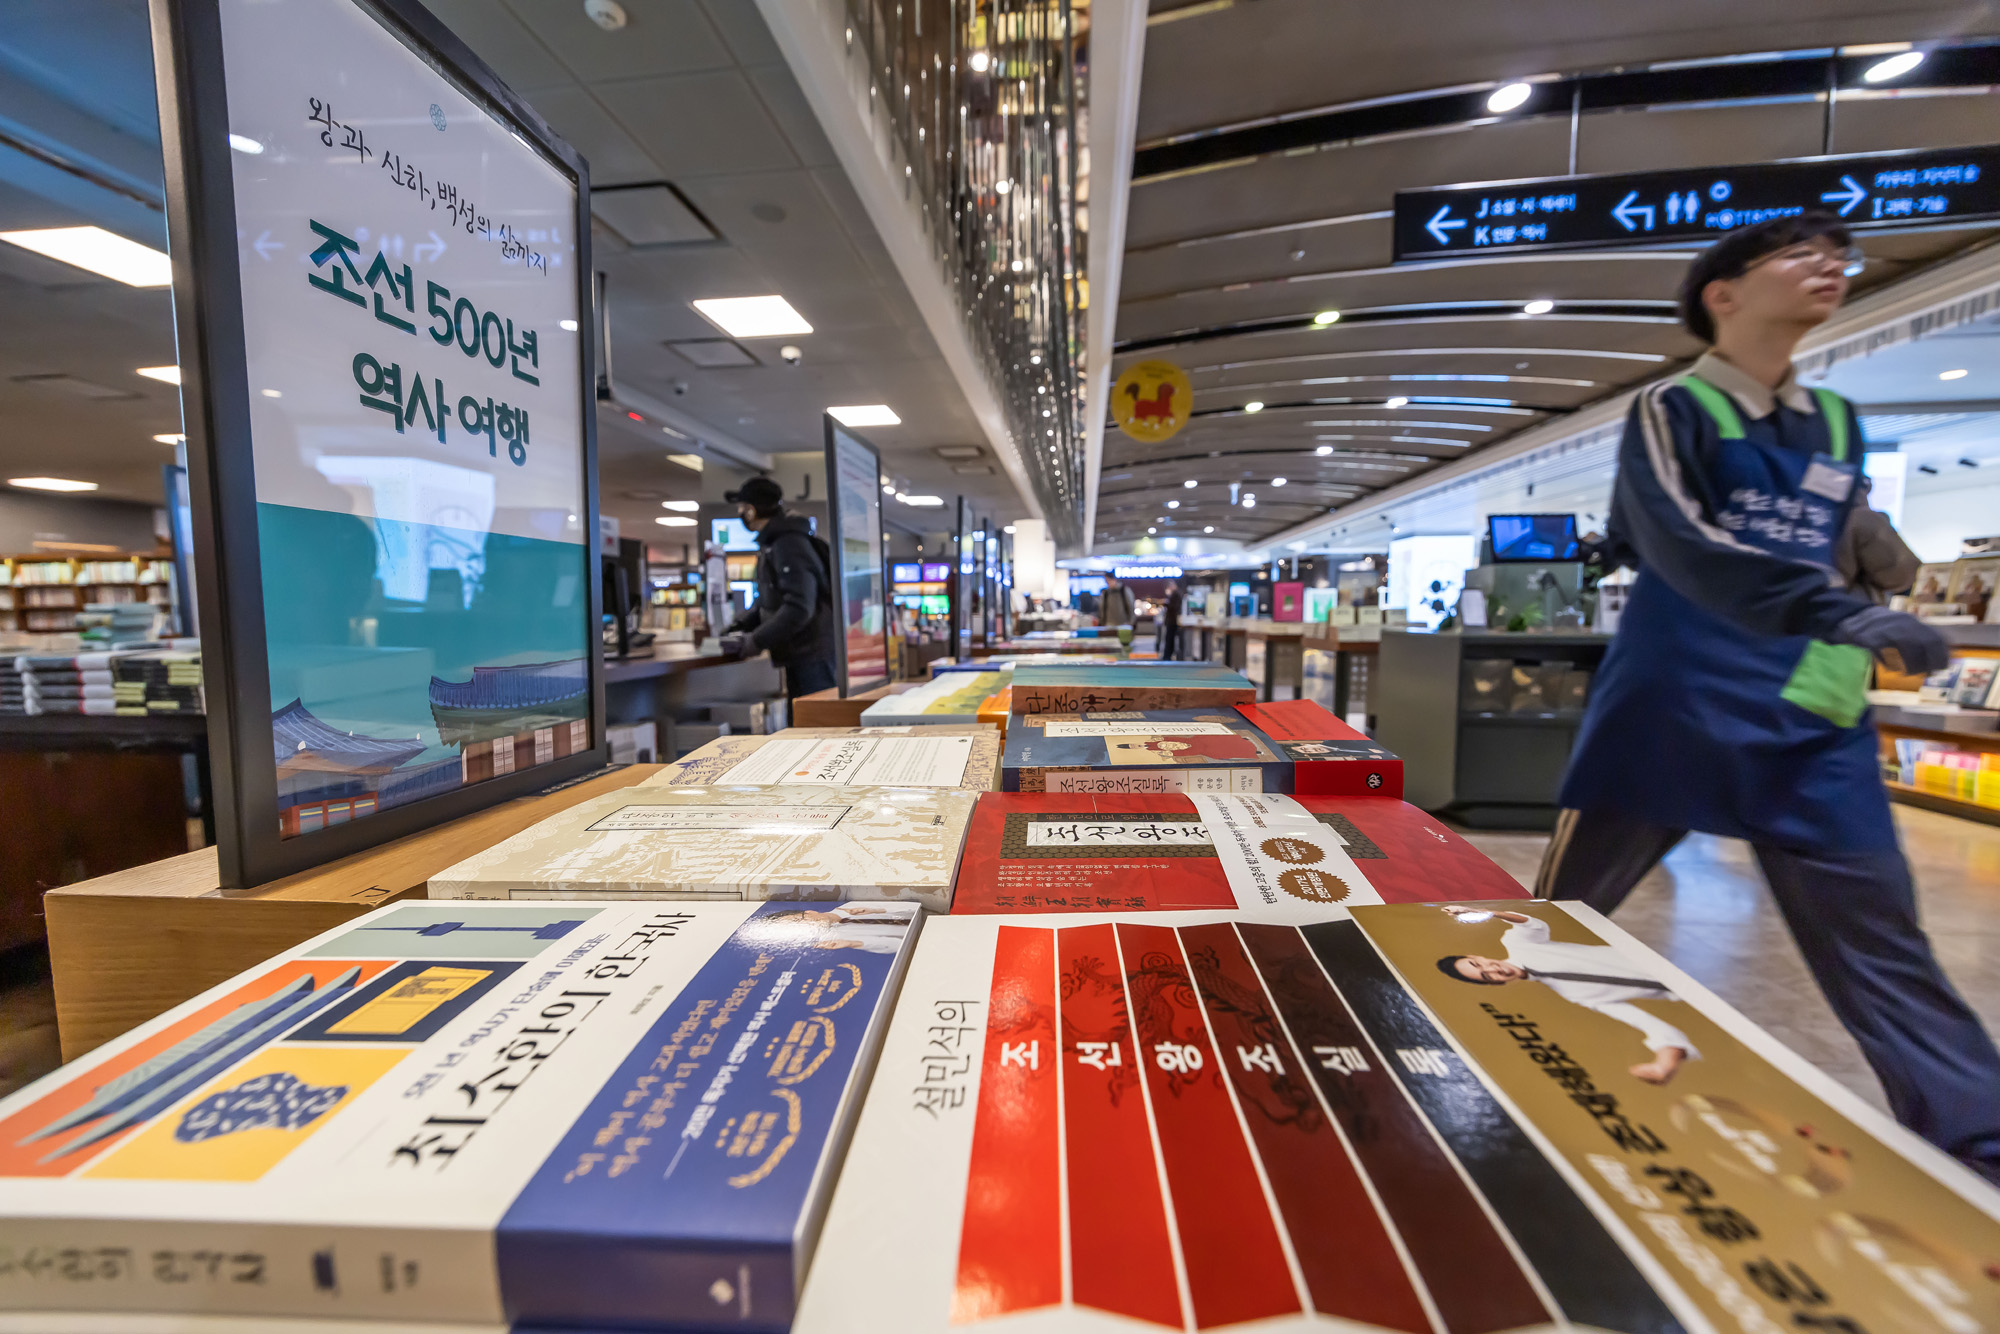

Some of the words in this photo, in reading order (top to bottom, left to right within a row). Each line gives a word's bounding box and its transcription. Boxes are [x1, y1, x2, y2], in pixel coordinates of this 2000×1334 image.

[308, 97, 373, 163] 왕과
[1474, 225, 1490, 246] K
[1475, 198, 1490, 219] J
[308, 218, 418, 336] 조선
[426, 279, 541, 387] 500년
[352, 352, 452, 445] 역사
[457, 394, 531, 467] 여행
[1060, 776, 1170, 794] 조선왕조실록
[1293, 874, 1315, 895] 2017년
[459, 1007, 520, 1048] 역사가
[510, 971, 564, 1004] 단숨에
[555, 933, 611, 968] 이해되는
[394, 990, 611, 1165] 최소한의
[585, 912, 697, 979] 한국사
[913, 999, 980, 1121] 설민석의
[1644, 1164, 1760, 1243] 항상
